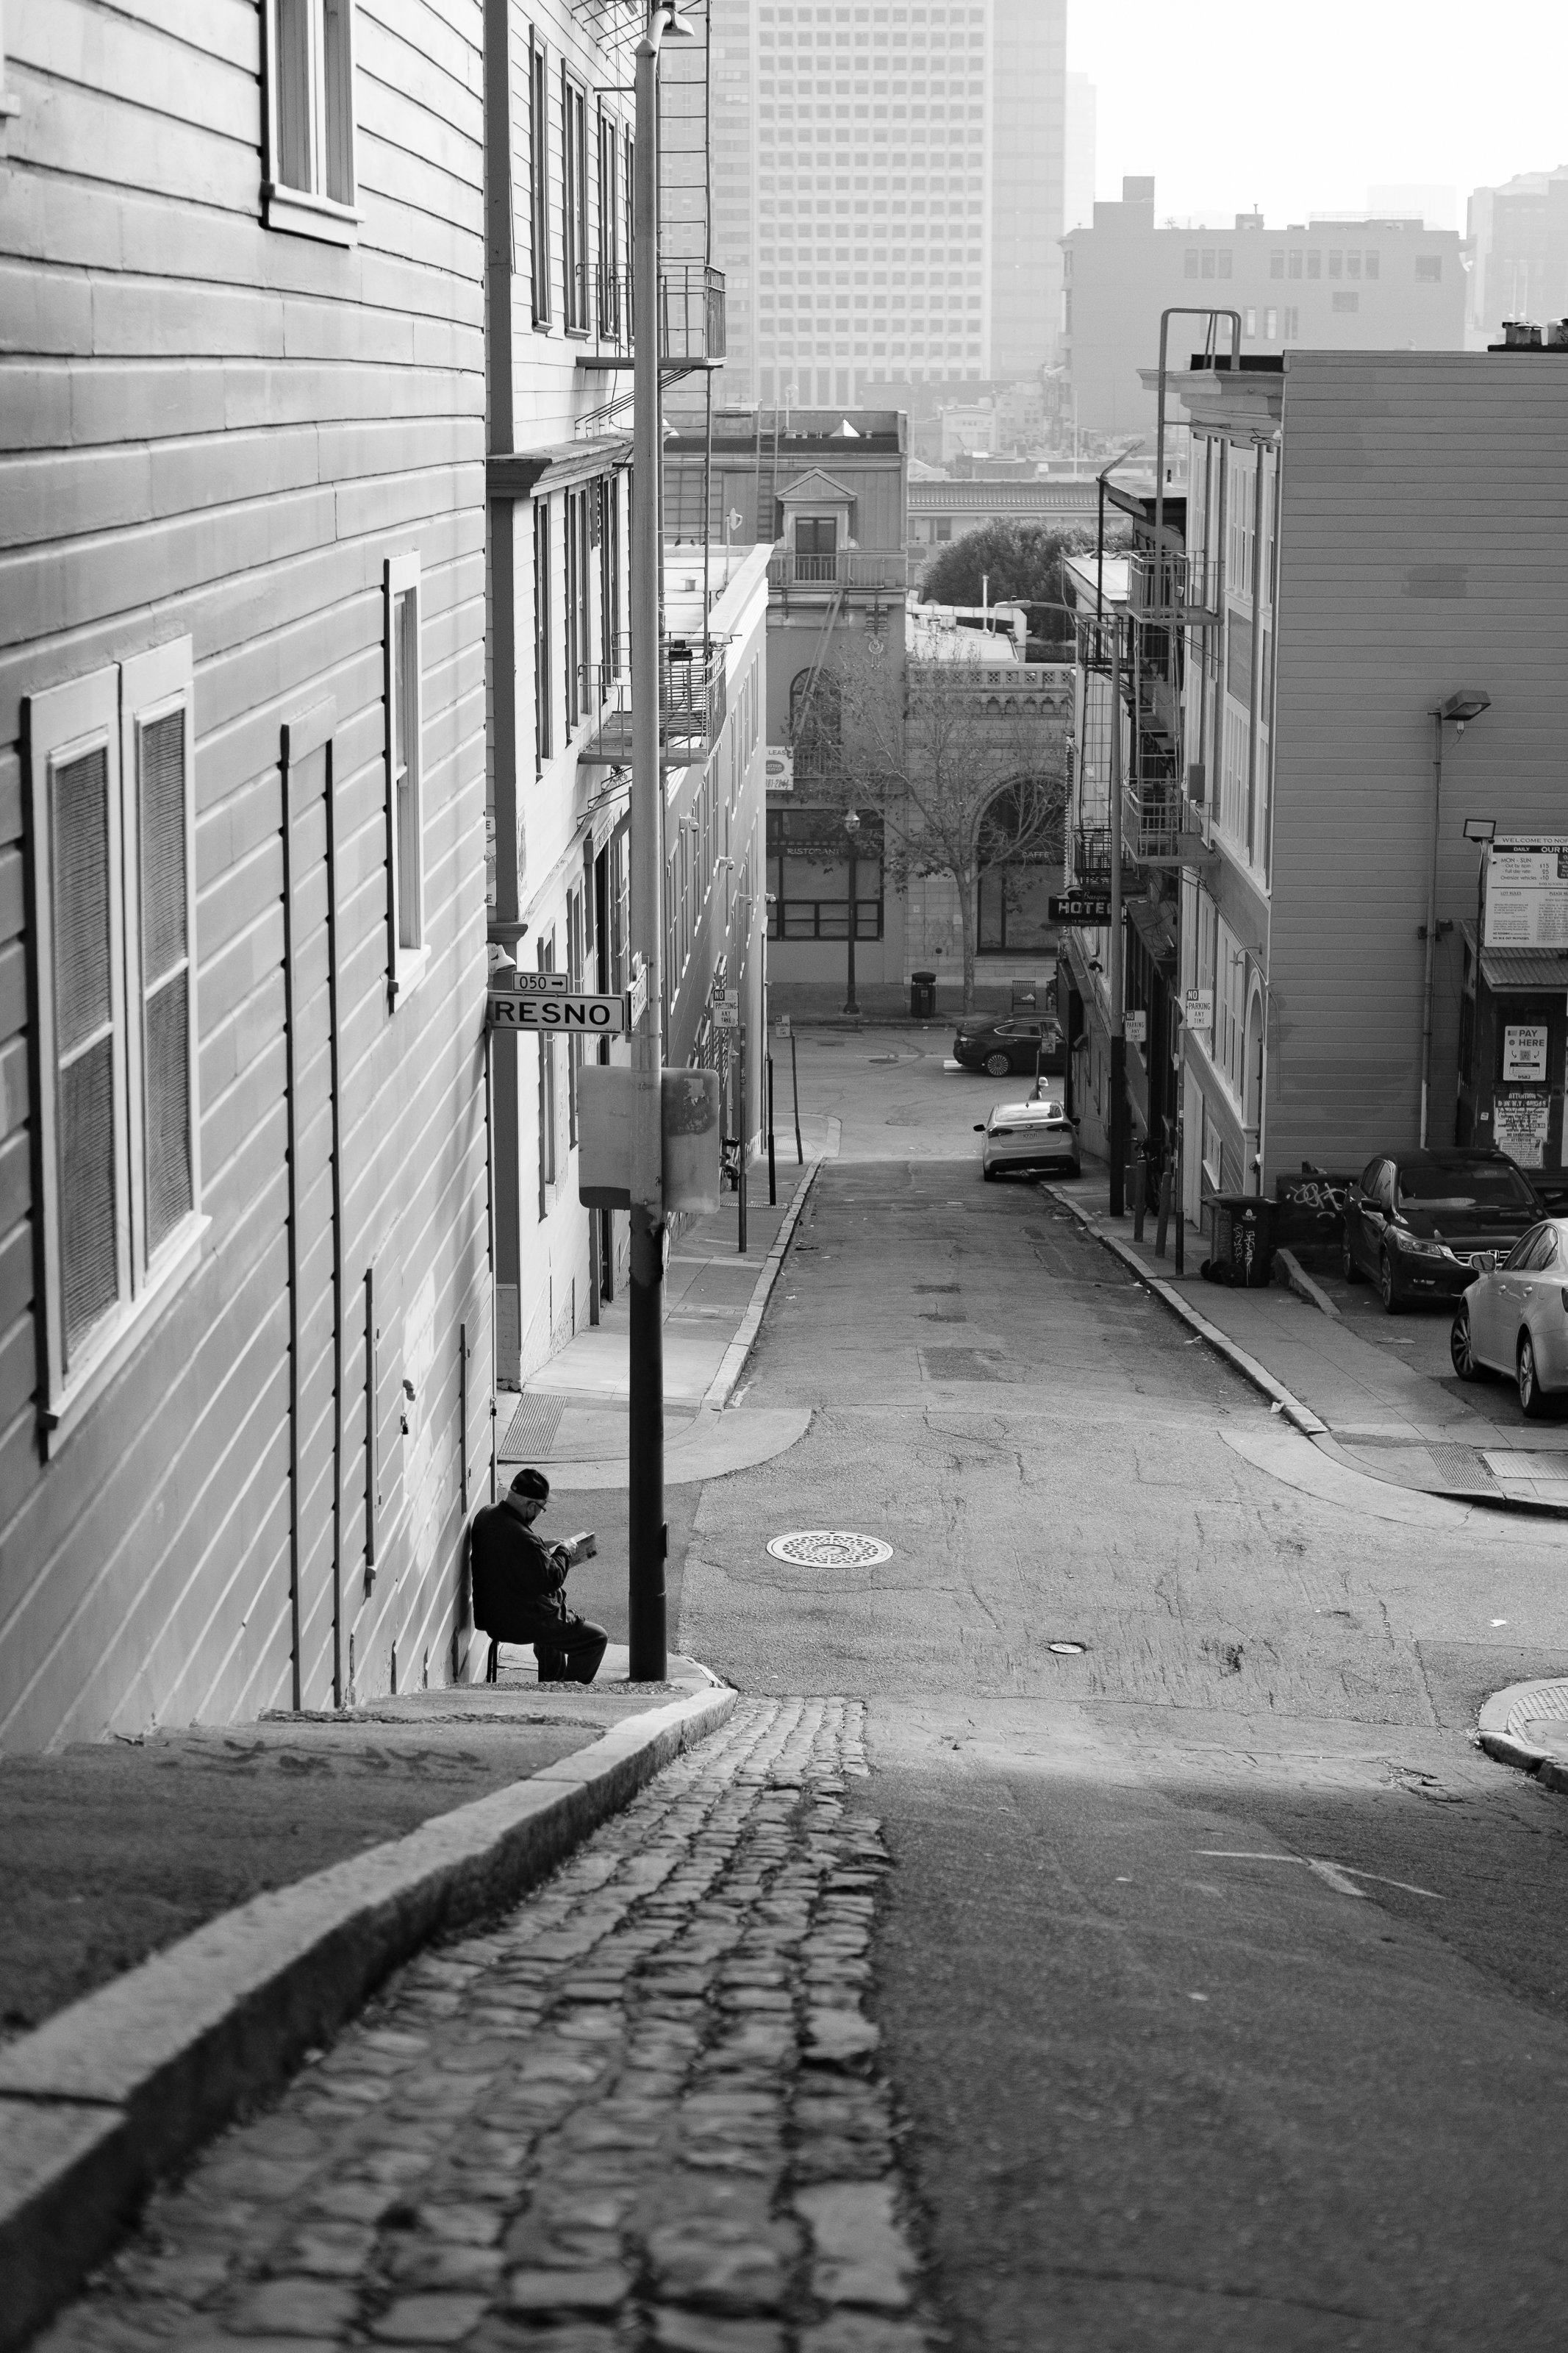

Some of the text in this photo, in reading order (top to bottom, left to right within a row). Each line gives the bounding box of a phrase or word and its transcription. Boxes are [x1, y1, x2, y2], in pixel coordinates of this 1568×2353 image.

[519, 976, 547, 990] 050
[715, 990, 723, 1000] NO
[1188, 990, 1198, 1000] NO
[489, 1001, 610, 1025] RESNO
[1519, 1039, 1545, 1047] HERE
